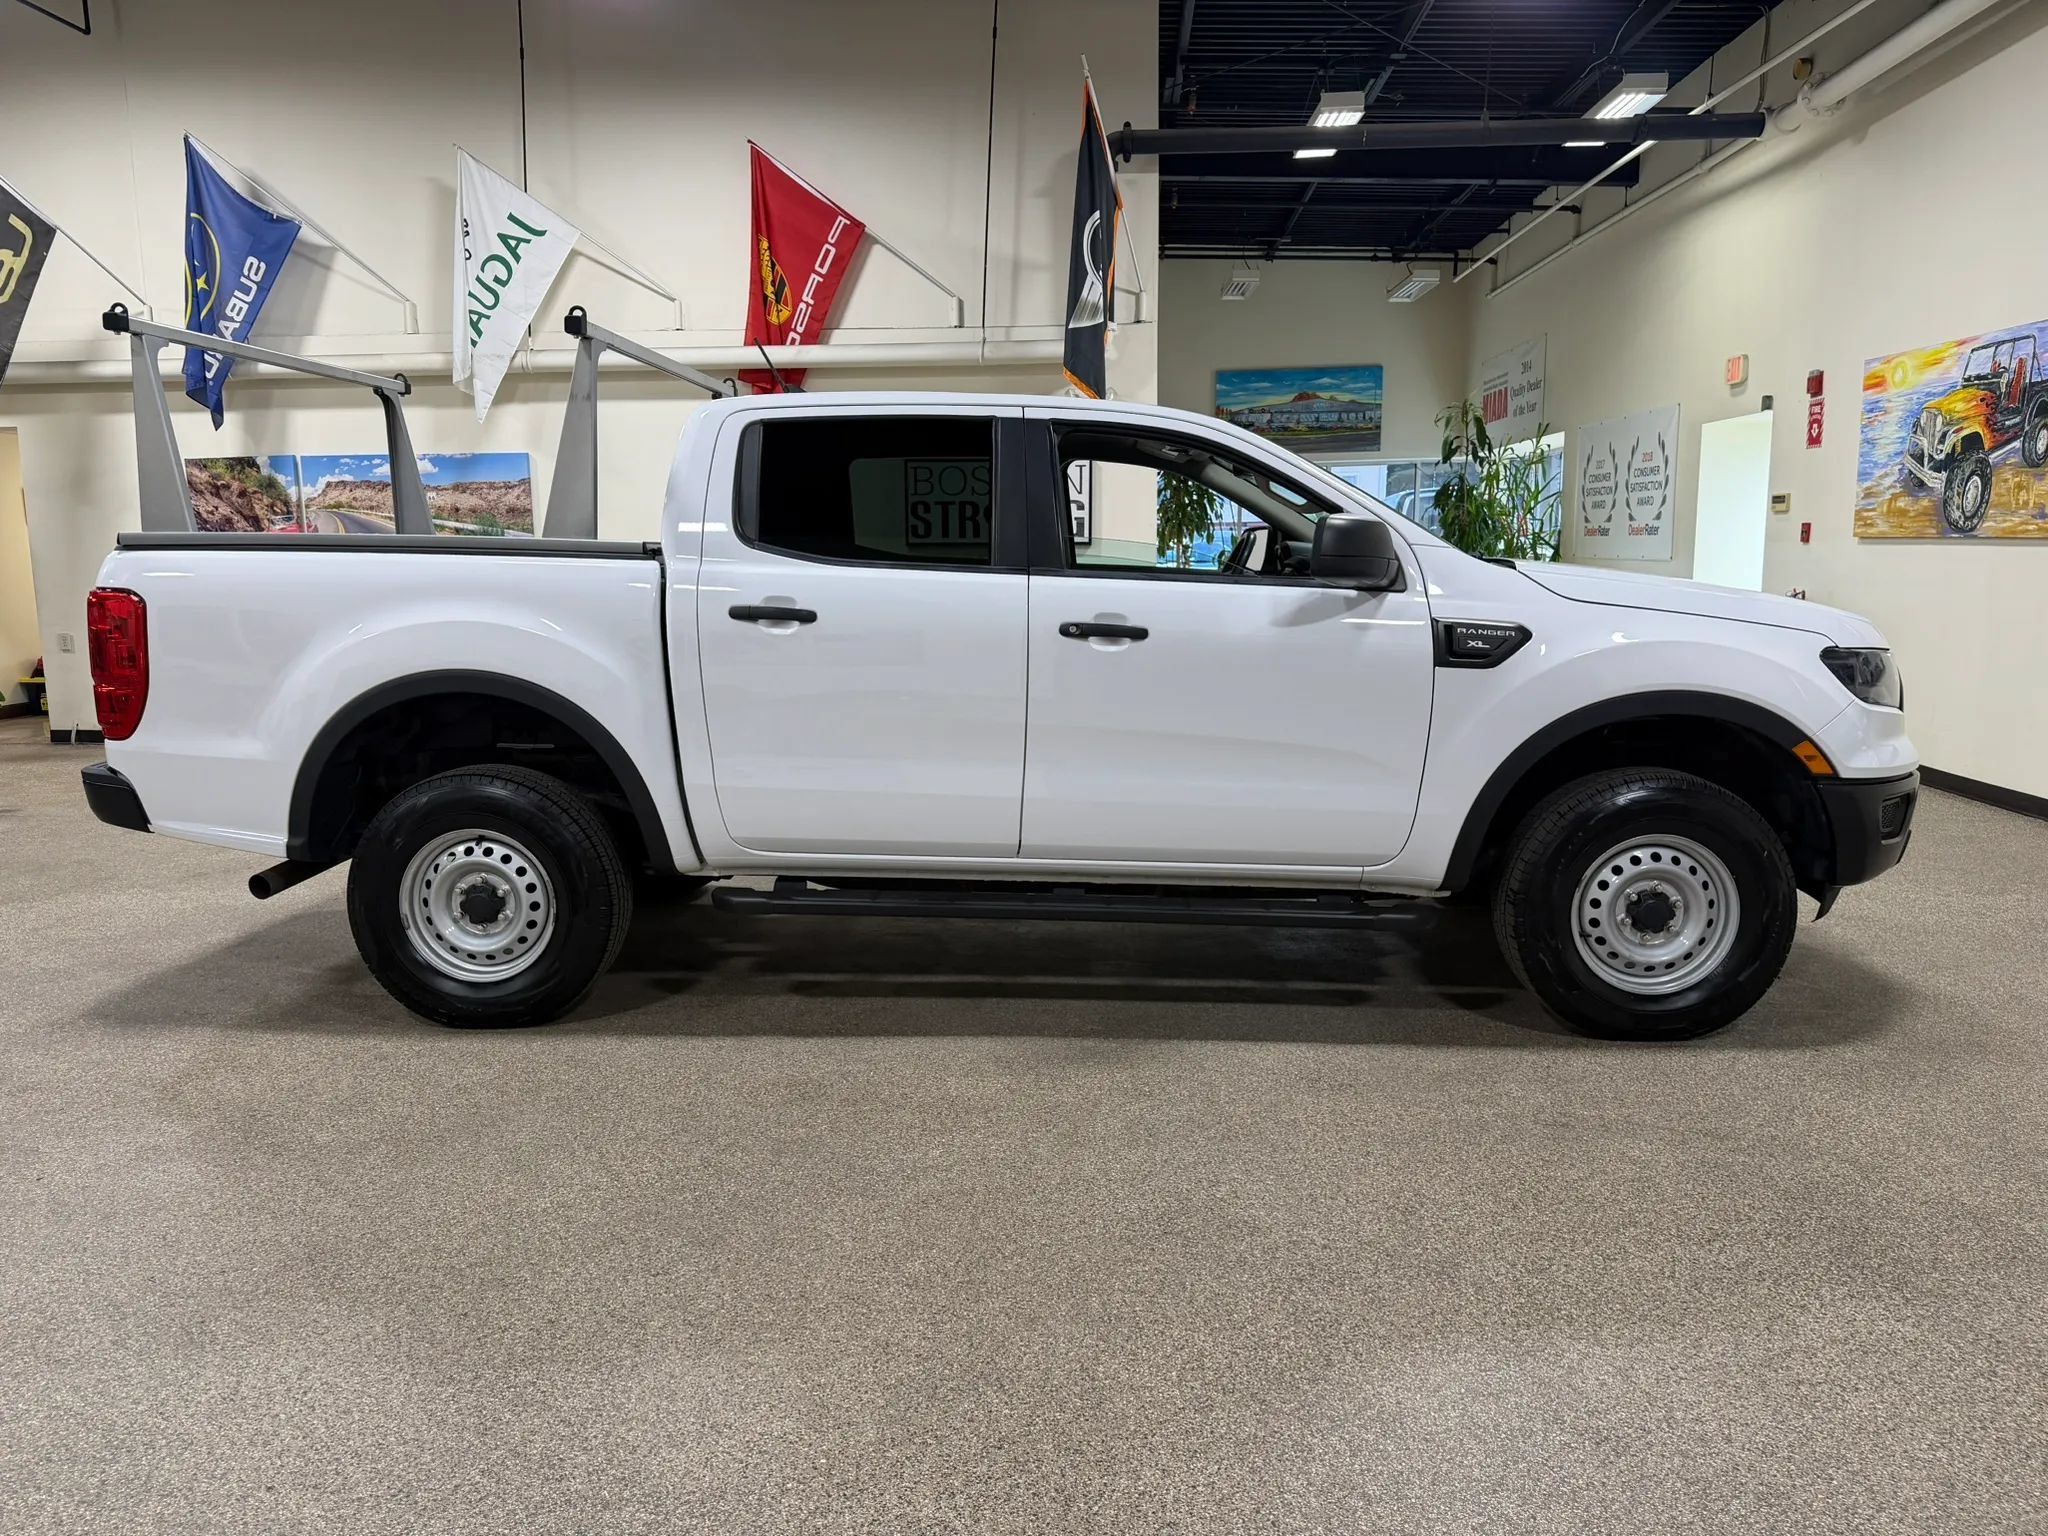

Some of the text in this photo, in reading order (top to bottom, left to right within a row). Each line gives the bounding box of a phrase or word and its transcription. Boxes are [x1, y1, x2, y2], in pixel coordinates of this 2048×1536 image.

[1521, 360, 1532, 375] 2014
[1510, 383, 1526, 400] Quality
[1526, 377, 1542, 393] Dealer
[1513, 401, 1537, 417] of the Year
[1811, 405, 1821, 413] FIRE
[1633, 465, 1661, 478] CONSUMER
[1588, 472, 1612, 484] CONSUMER
[1585, 486, 1614, 497] SATISFACTION
[1630, 480, 1663, 493] SATISFACTION
[1590, 499, 1607, 510] AWARD
[1636, 495, 1655, 507] AWARD
[1584, 525, 1611, 537] DealerRater
[1628, 523, 1660, 536] DealerRater
[1457, 627, 1516, 637] RANGER
[1466, 640, 1491, 648] XL
